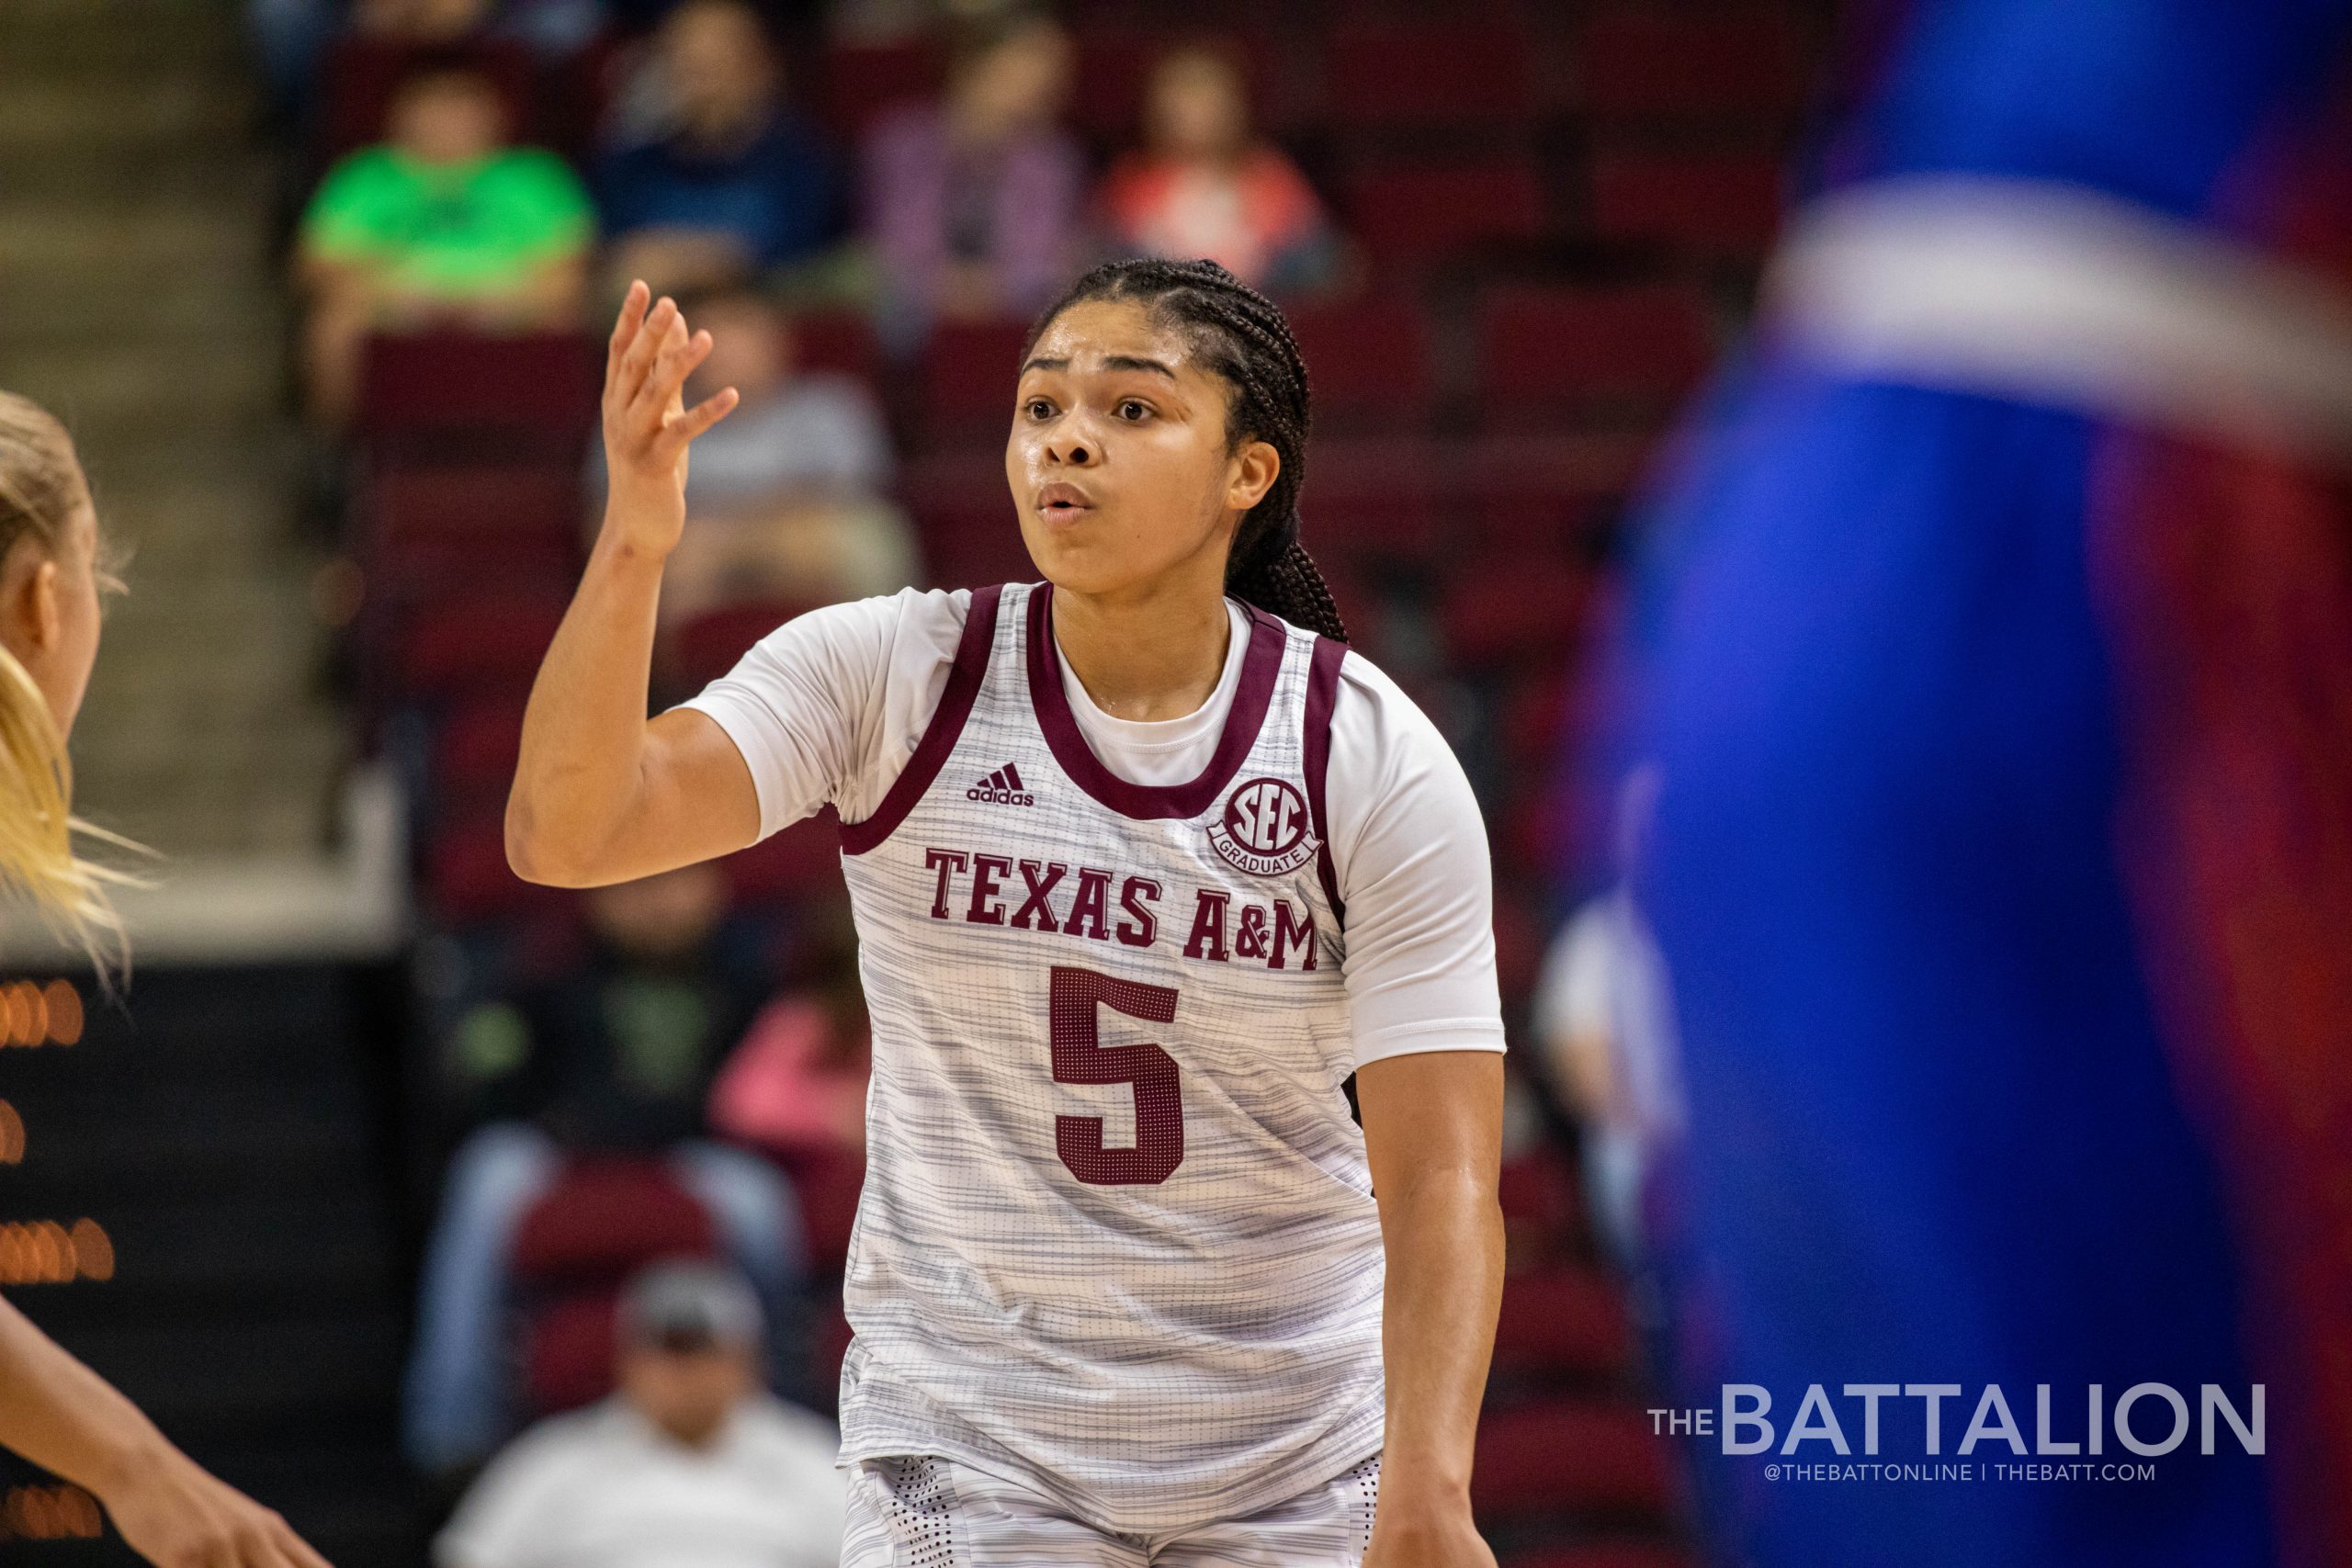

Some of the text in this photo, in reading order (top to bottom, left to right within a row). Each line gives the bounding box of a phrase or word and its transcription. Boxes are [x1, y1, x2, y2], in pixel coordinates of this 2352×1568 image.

[967, 786, 1034, 807] adidas
[1234, 783, 1301, 851] SEC
[1218, 839, 1303, 874] GRADUATE
[925, 848, 1317, 971] TEXAS A&M
[1050, 966, 1183, 1185] 5
